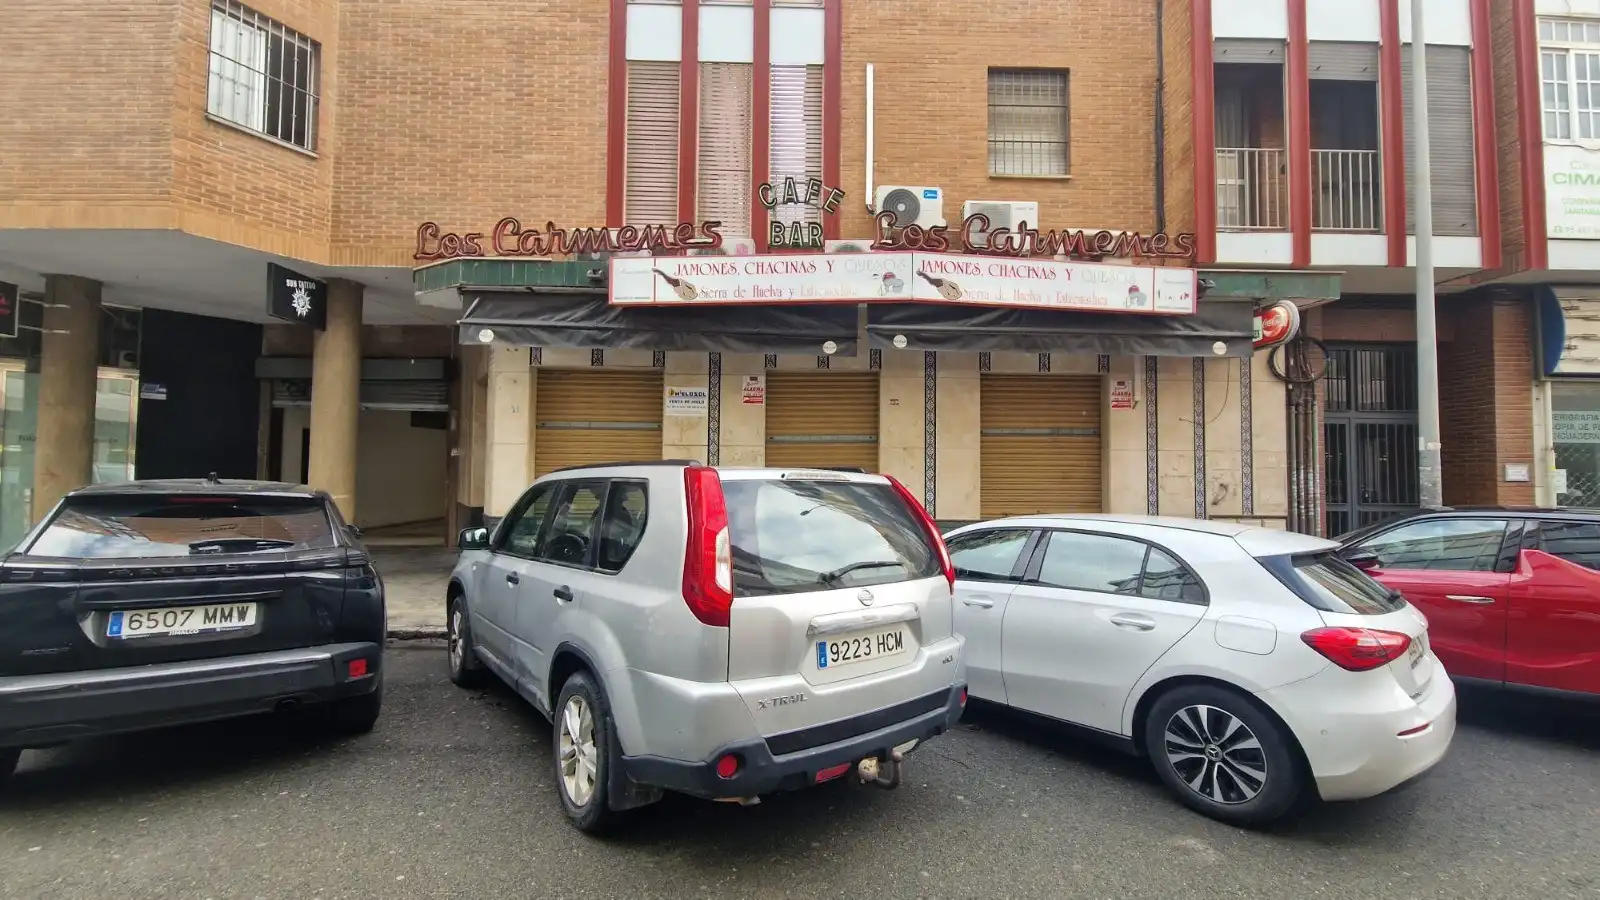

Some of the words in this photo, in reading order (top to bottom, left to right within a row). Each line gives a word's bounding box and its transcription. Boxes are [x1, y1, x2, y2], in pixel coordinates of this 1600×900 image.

[413, 221, 485, 260] Los
[492, 216, 723, 256] Carmenes
[770, 221, 823, 248] BAR
[870, 210, 949, 252] Los
[961, 213, 1196, 259] Carmenes
[673, 262, 740, 276] JAMONES,
[744, 260, 817, 276] CHACINAS
[826, 260, 835, 273] Y
[920, 260, 983, 277] JAMONES,
[988, 263, 1057, 280] CHACINAS
[1065, 268, 1074, 281] Y
[698, 286, 728, 299] Sierra
[733, 284, 747, 298] de
[788, 288, 795, 300] y
[127, 609, 195, 631] 6507
[203, 605, 250, 625] MMW
[830, 636, 872, 663] 9223
[876, 631, 903, 655] HCM
